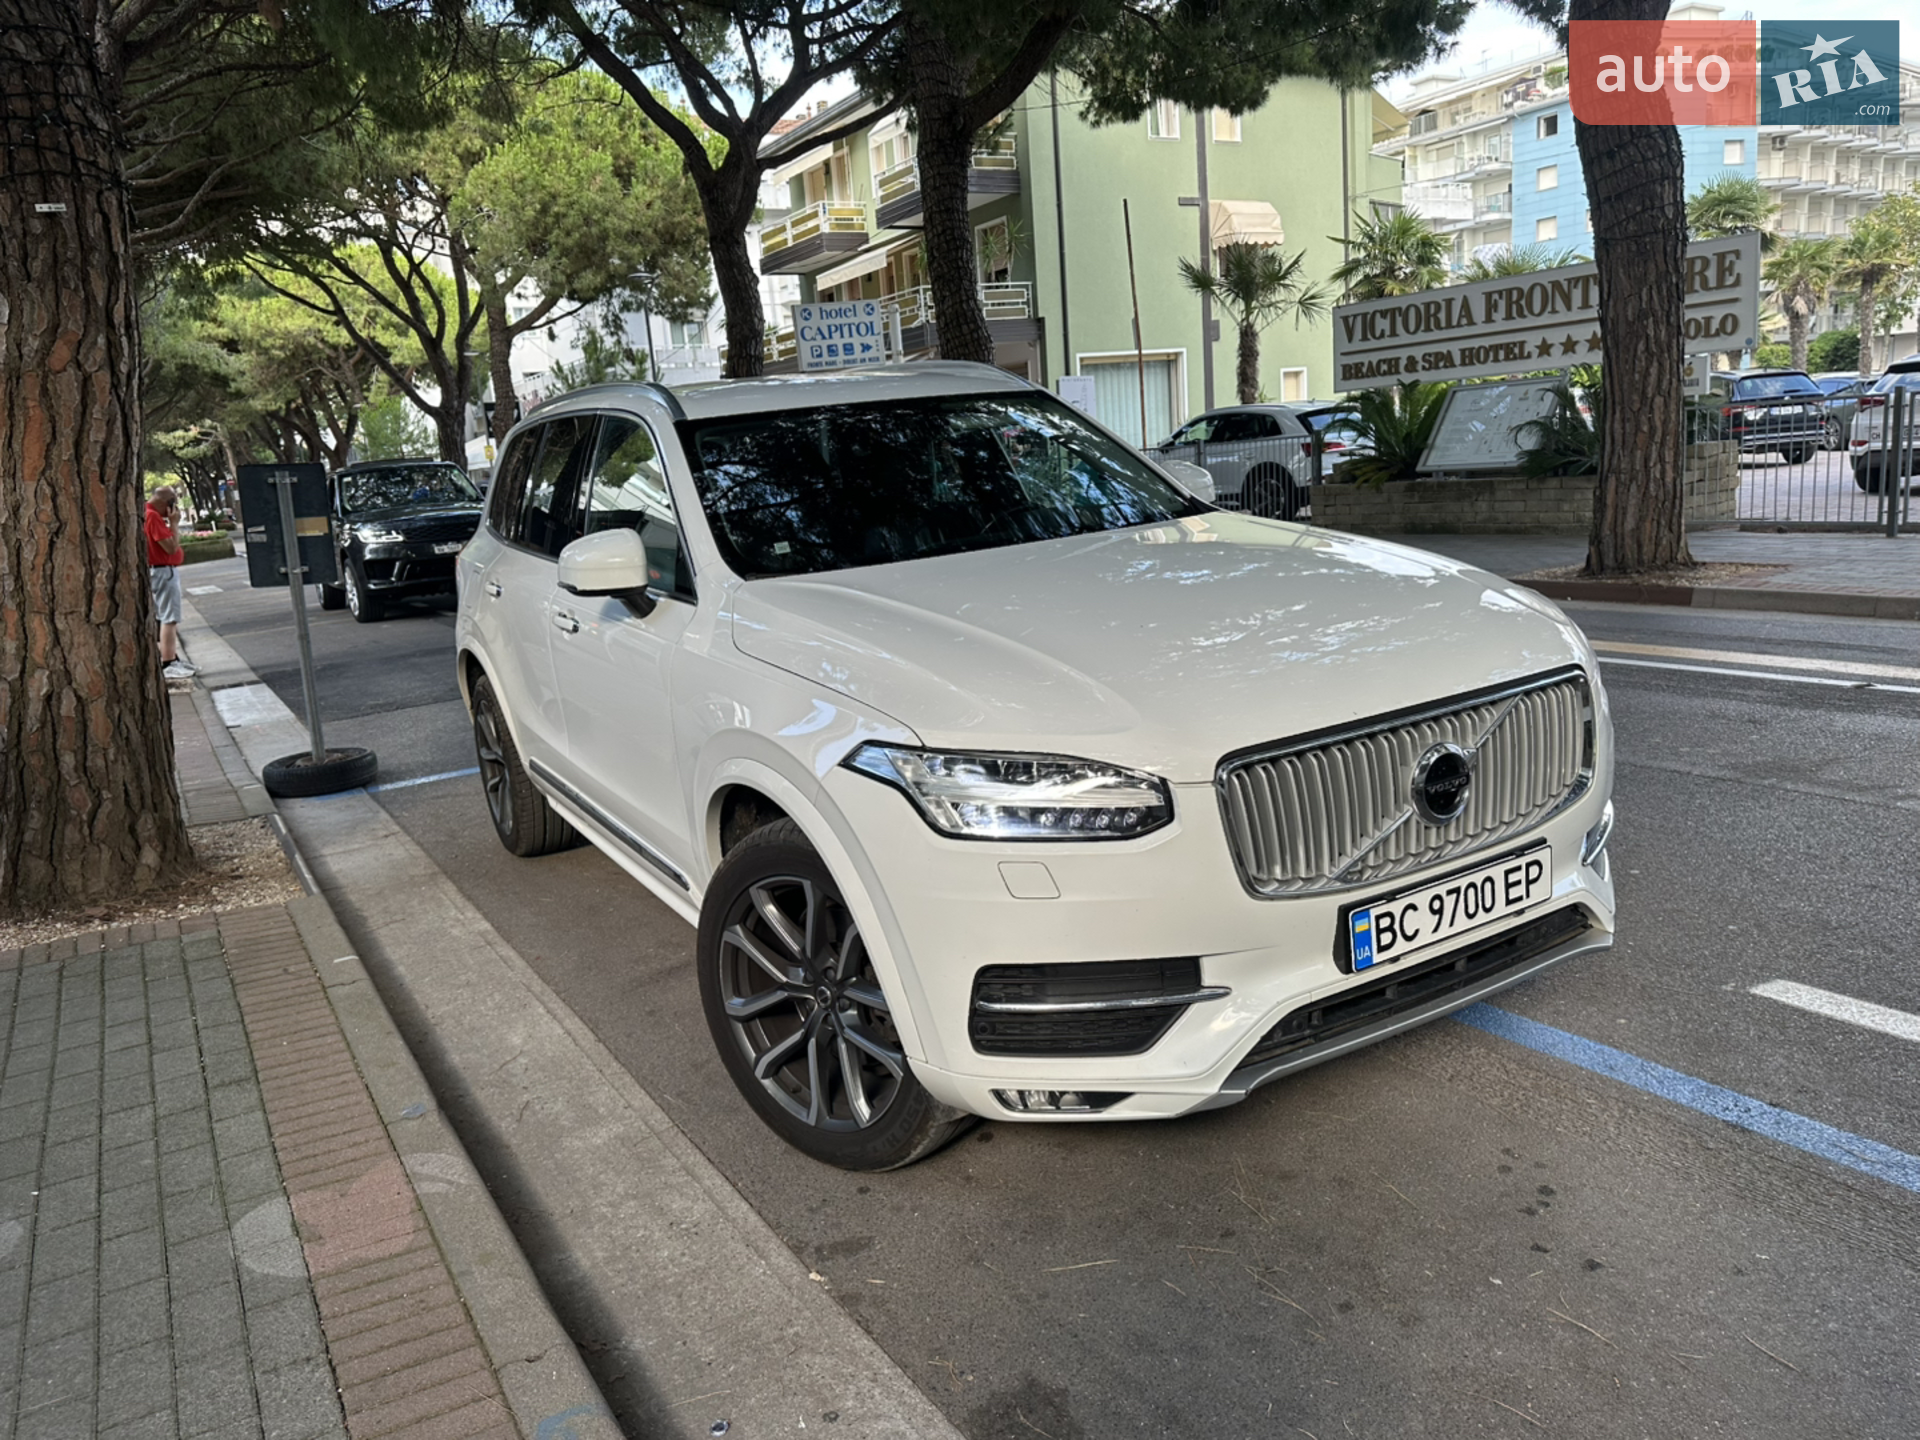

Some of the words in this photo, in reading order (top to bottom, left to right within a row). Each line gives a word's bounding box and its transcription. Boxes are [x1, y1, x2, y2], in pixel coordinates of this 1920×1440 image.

[819, 304, 858, 320] hotel
[1339, 294, 1477, 344] VICTORIA
[1482, 272, 1600, 324] FRONT
[800, 321, 880, 342] CAPITOL
[1340, 355, 1400, 381] BEACH
[1403, 354, 1418, 373] &
[1421, 350, 1456, 372] SPA
[1458, 340, 1532, 367] HOTEL
[1684, 312, 1740, 341] OLO
[1426, 776, 1467, 794] VOLVO
[1355, 944, 1371, 961] UA
[1374, 902, 1420, 954] BC
[1428, 875, 1496, 935] 9700
[1503, 859, 1544, 907] EP
